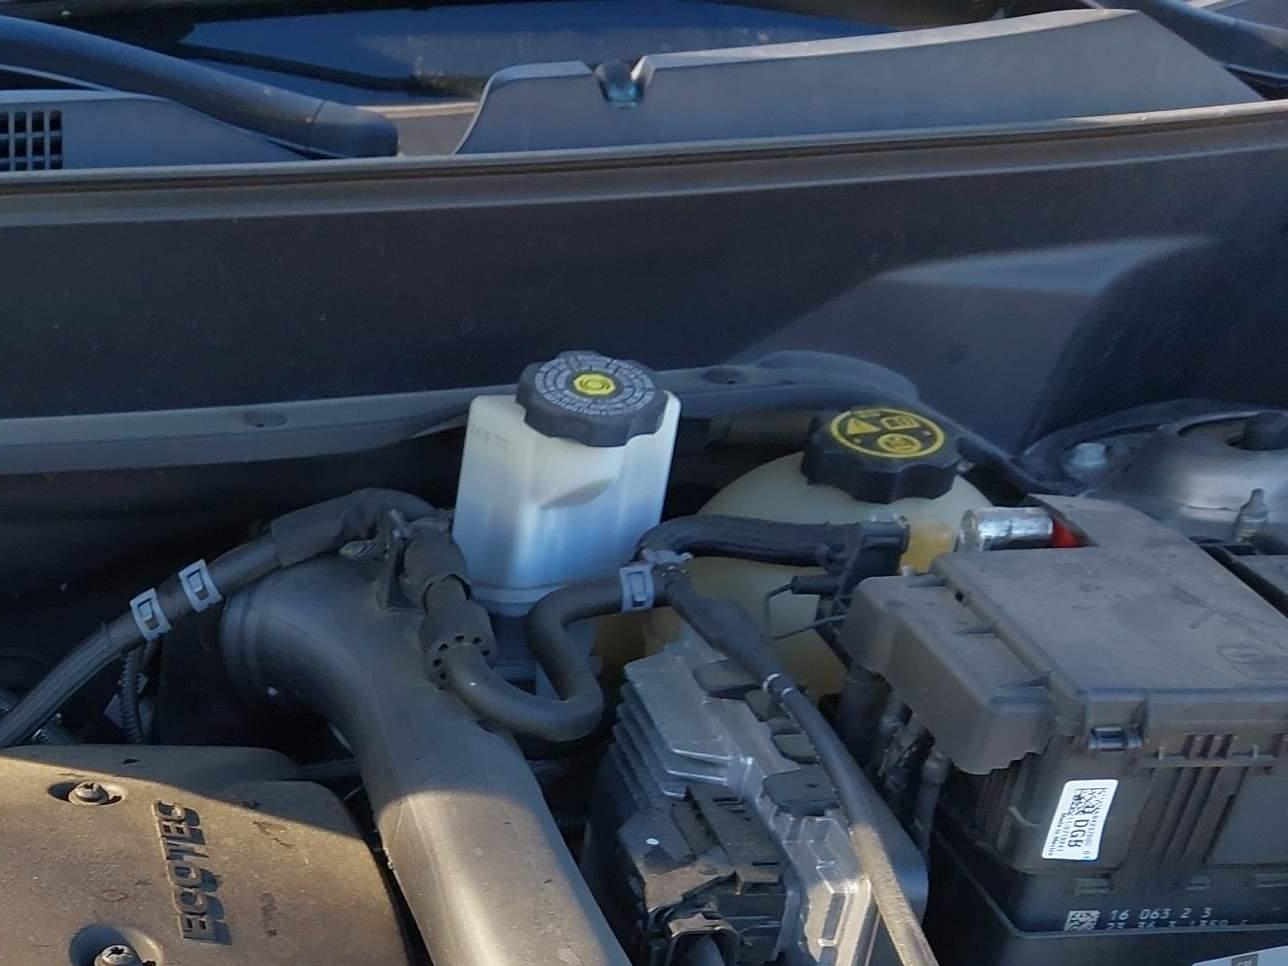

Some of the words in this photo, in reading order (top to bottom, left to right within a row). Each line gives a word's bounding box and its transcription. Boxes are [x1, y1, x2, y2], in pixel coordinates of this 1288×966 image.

[1068, 819, 1090, 848] DGB
[151, 800, 219, 942] ECOTEC
[1110, 908, 1131, 921] 16
[1138, 908, 1173, 920] 063
[1179, 907, 1193, 919] 2
[1200, 906, 1214, 919] 3
